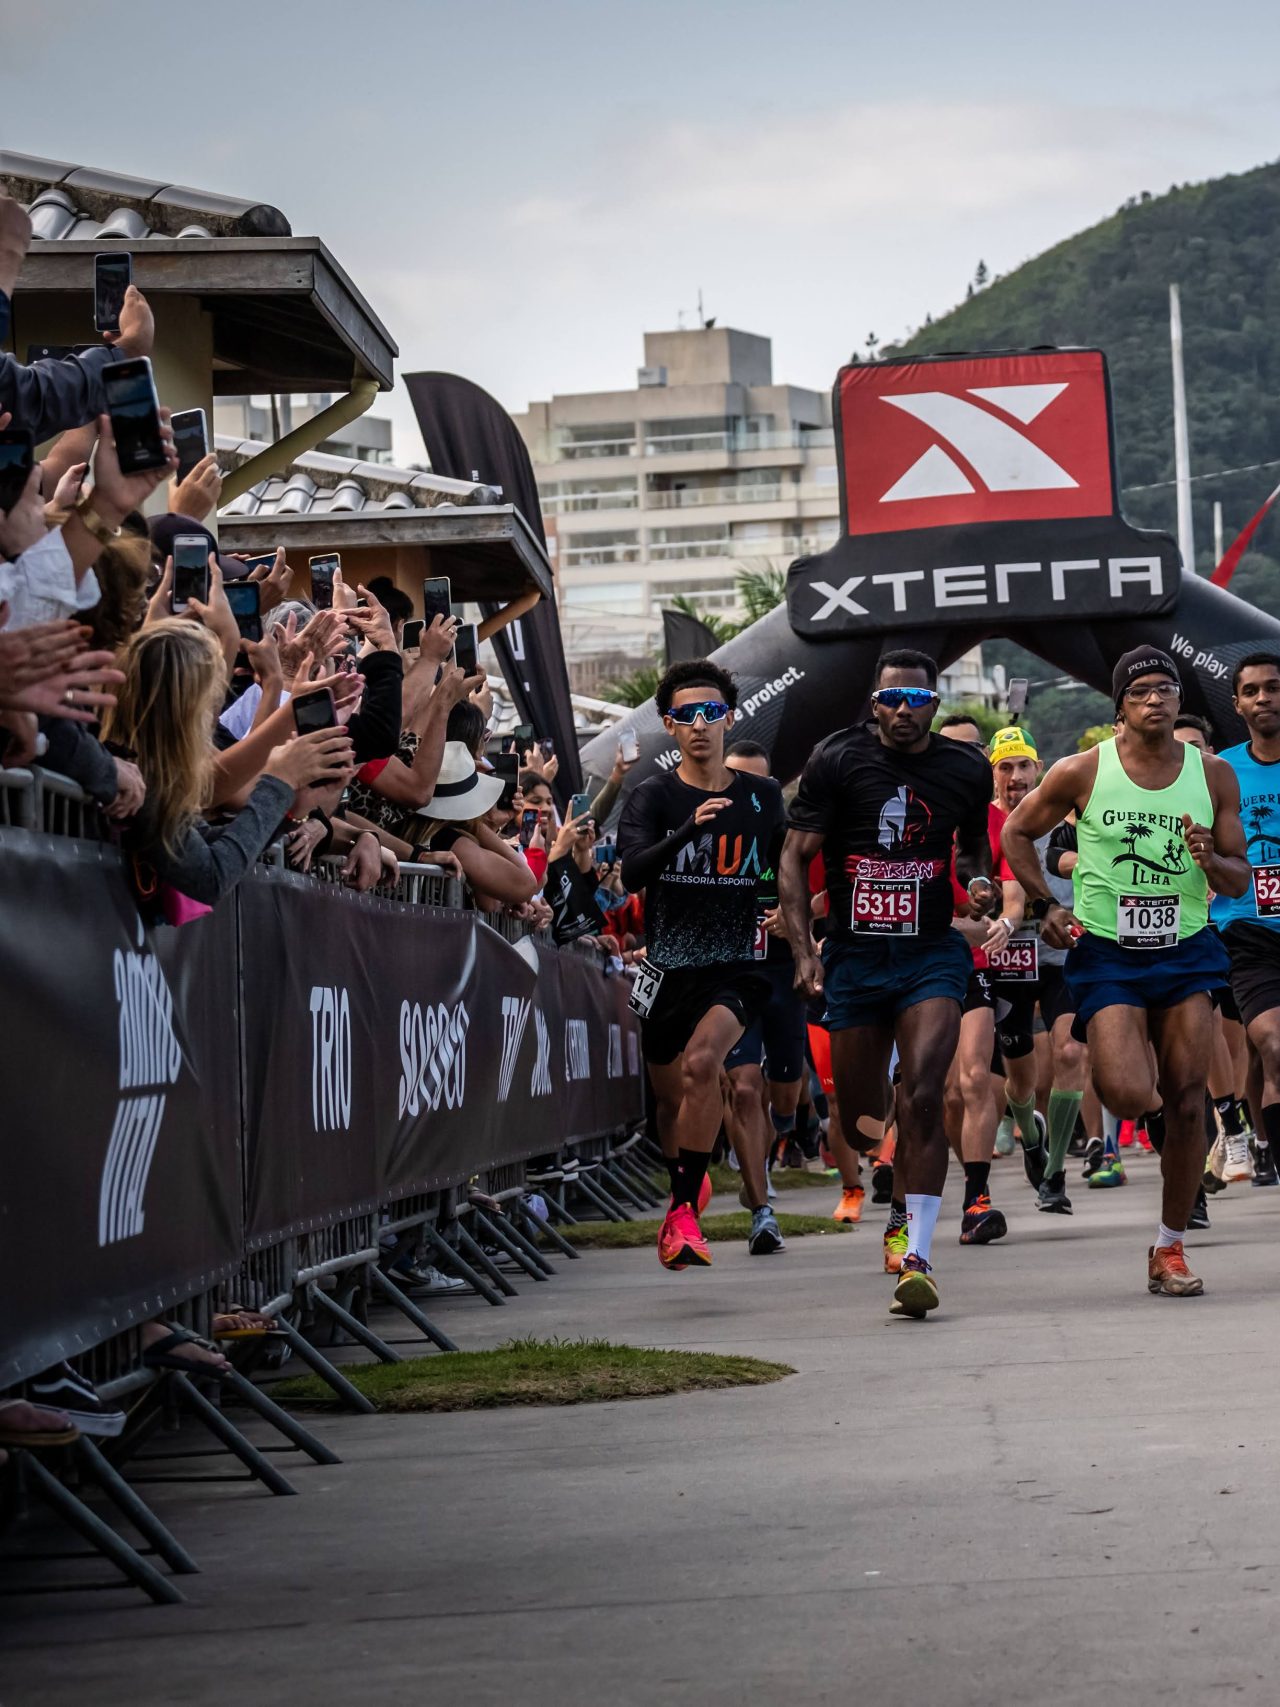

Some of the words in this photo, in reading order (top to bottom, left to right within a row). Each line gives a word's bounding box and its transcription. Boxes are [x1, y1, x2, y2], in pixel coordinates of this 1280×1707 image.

[809, 556, 1164, 621] XTERRA
[1127, 659, 1159, 675] POLO
[1170, 633, 1193, 659] We
[1192, 650, 1229, 680] play.
[654, 749, 682, 771] We
[742, 666, 806, 717] protect.
[1102, 809, 1198, 838] GUERREIR
[659, 873, 716, 885] ASSESSORIA
[717, 877, 757, 887] ESPORTIV
[856, 859, 934, 880] SPARTAN
[1131, 862, 1171, 886] ILHA
[856, 892, 912, 916] 5315
[1138, 898, 1175, 906] XTERRA
[1125, 906, 1176, 930] 1038
[990, 949, 1032, 967] 5043
[309, 985, 351, 1133] TRIO
